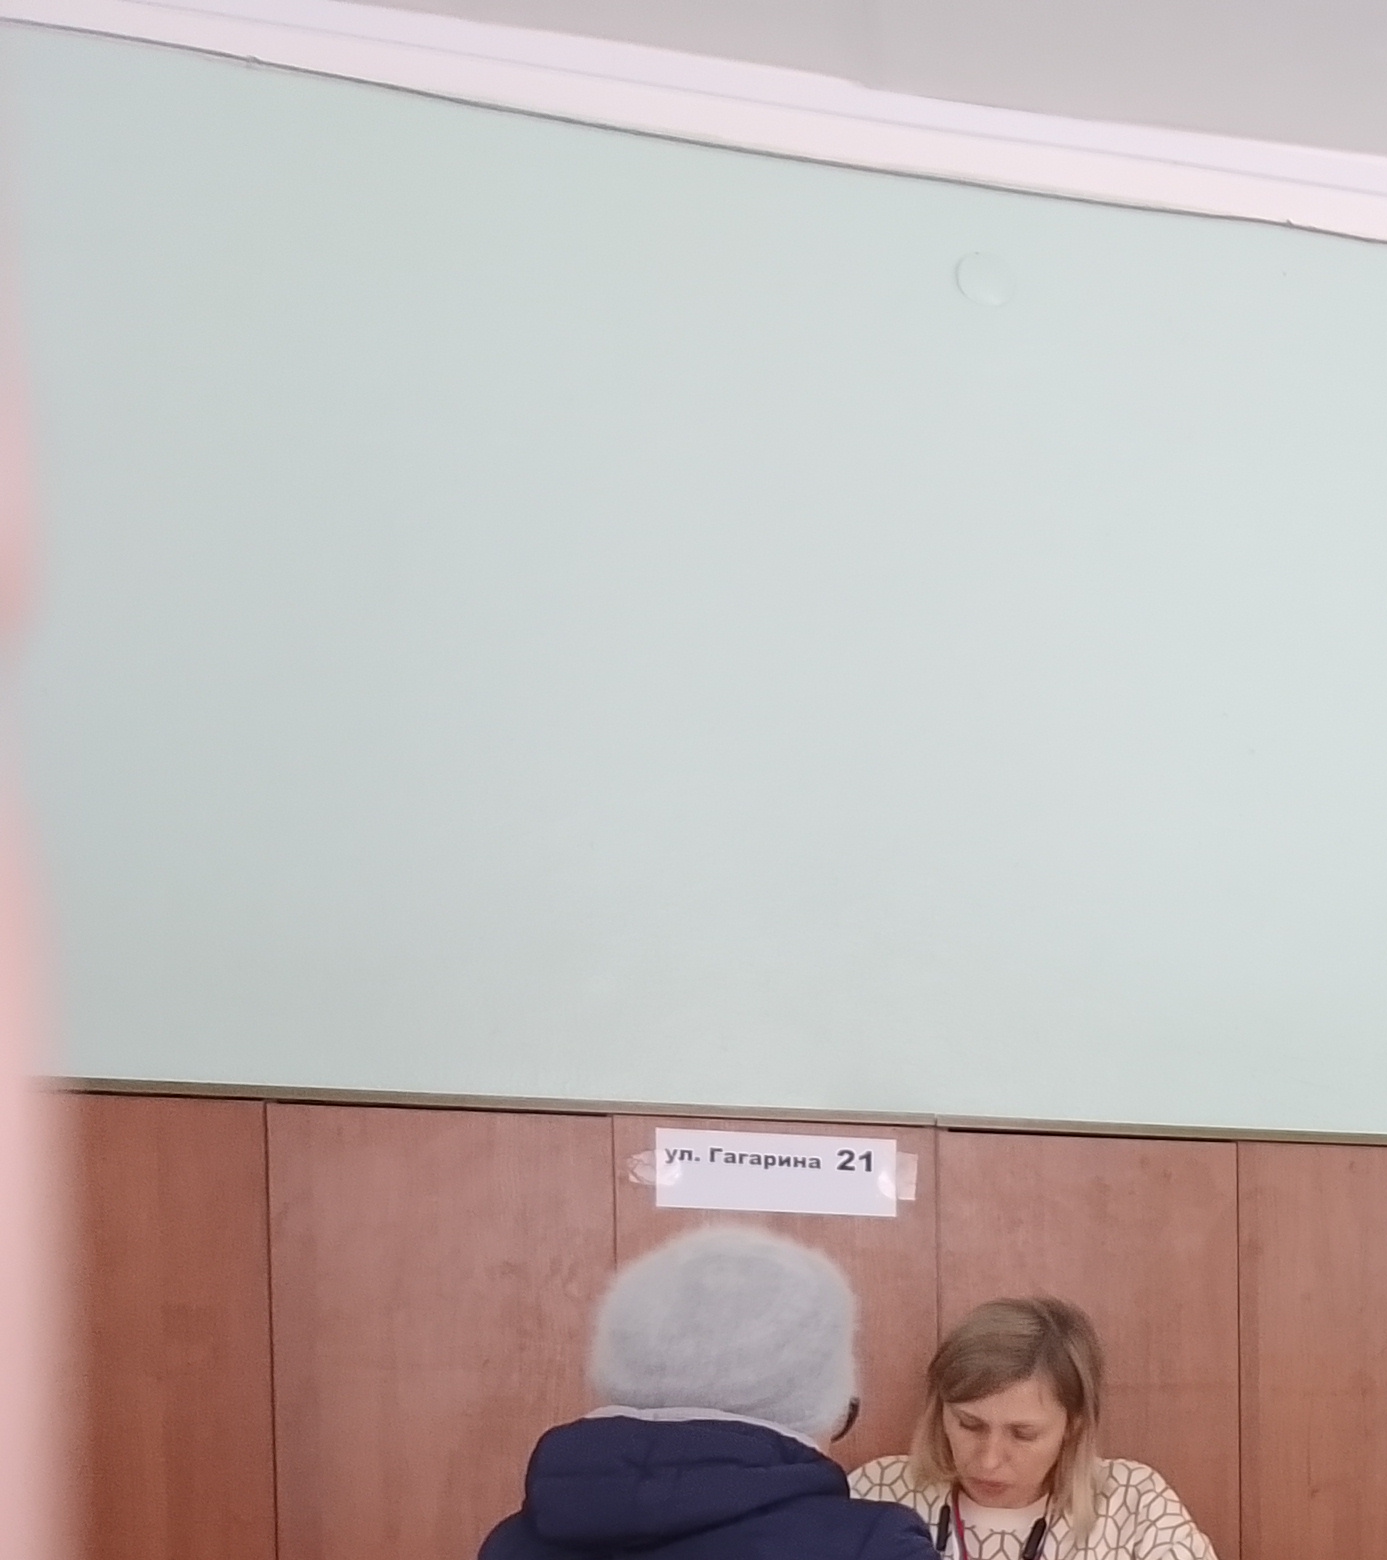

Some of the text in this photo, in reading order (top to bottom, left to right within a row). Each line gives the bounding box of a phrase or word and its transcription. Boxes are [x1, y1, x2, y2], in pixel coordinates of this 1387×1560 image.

[664, 1147, 874, 1173] ул. Гагарина 21
